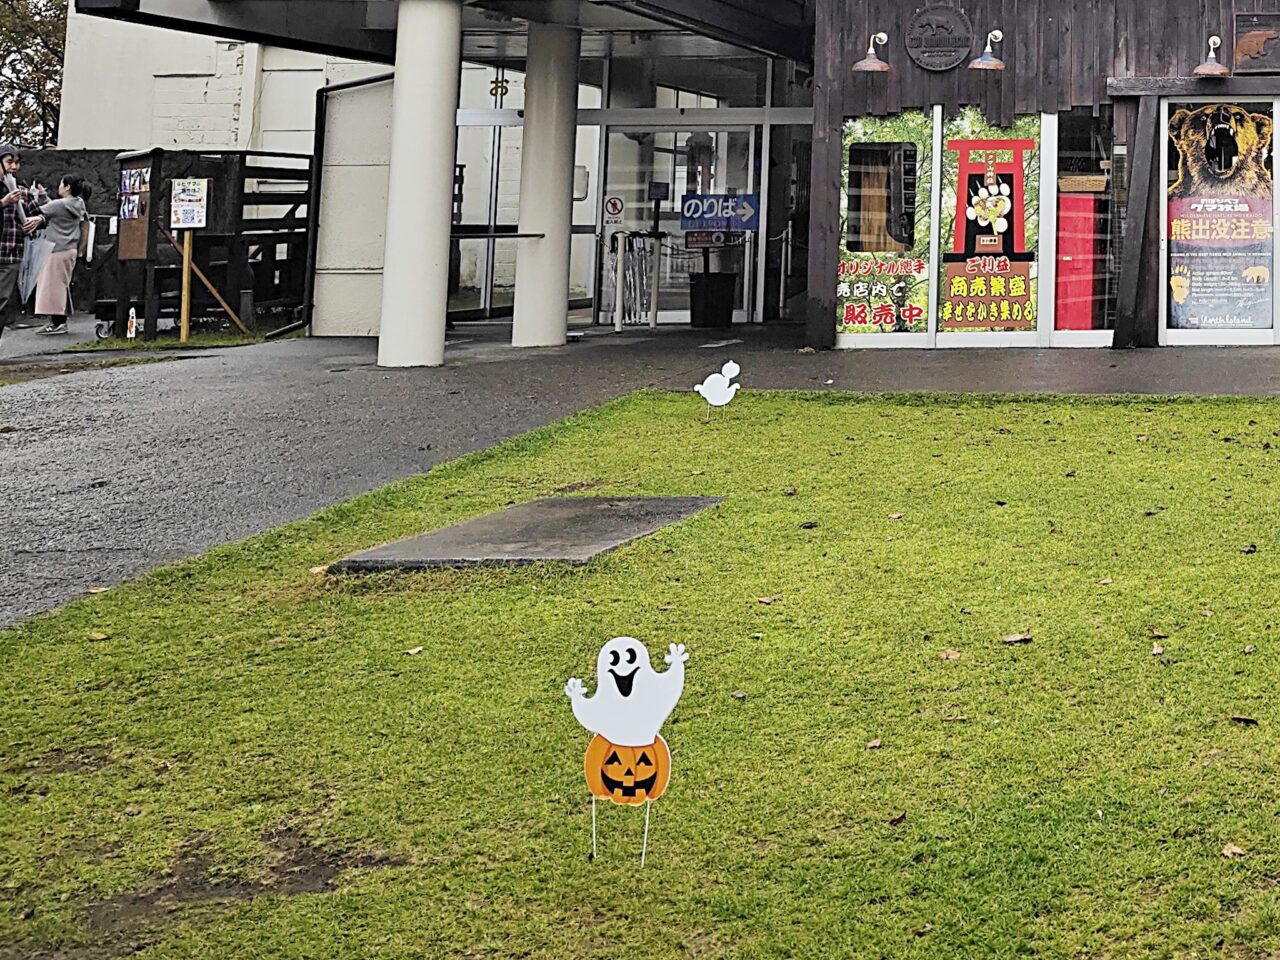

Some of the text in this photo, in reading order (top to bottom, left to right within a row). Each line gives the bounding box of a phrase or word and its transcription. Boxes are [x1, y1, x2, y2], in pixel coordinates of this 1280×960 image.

[683, 198, 737, 218] のりば
[1190, 203, 1249, 212] クマ牧場
[1171, 218, 1271, 240] 熊出没注意
[837, 260, 926, 276] オリジナル熊手
[965, 256, 1011, 274] ご利益
[837, 282, 906, 298] 売店内で
[950, 275, 1027, 298] 商売繁盛
[843, 303, 924, 326] 販売中
[942, 300, 1035, 323] 幸せをかき集める
